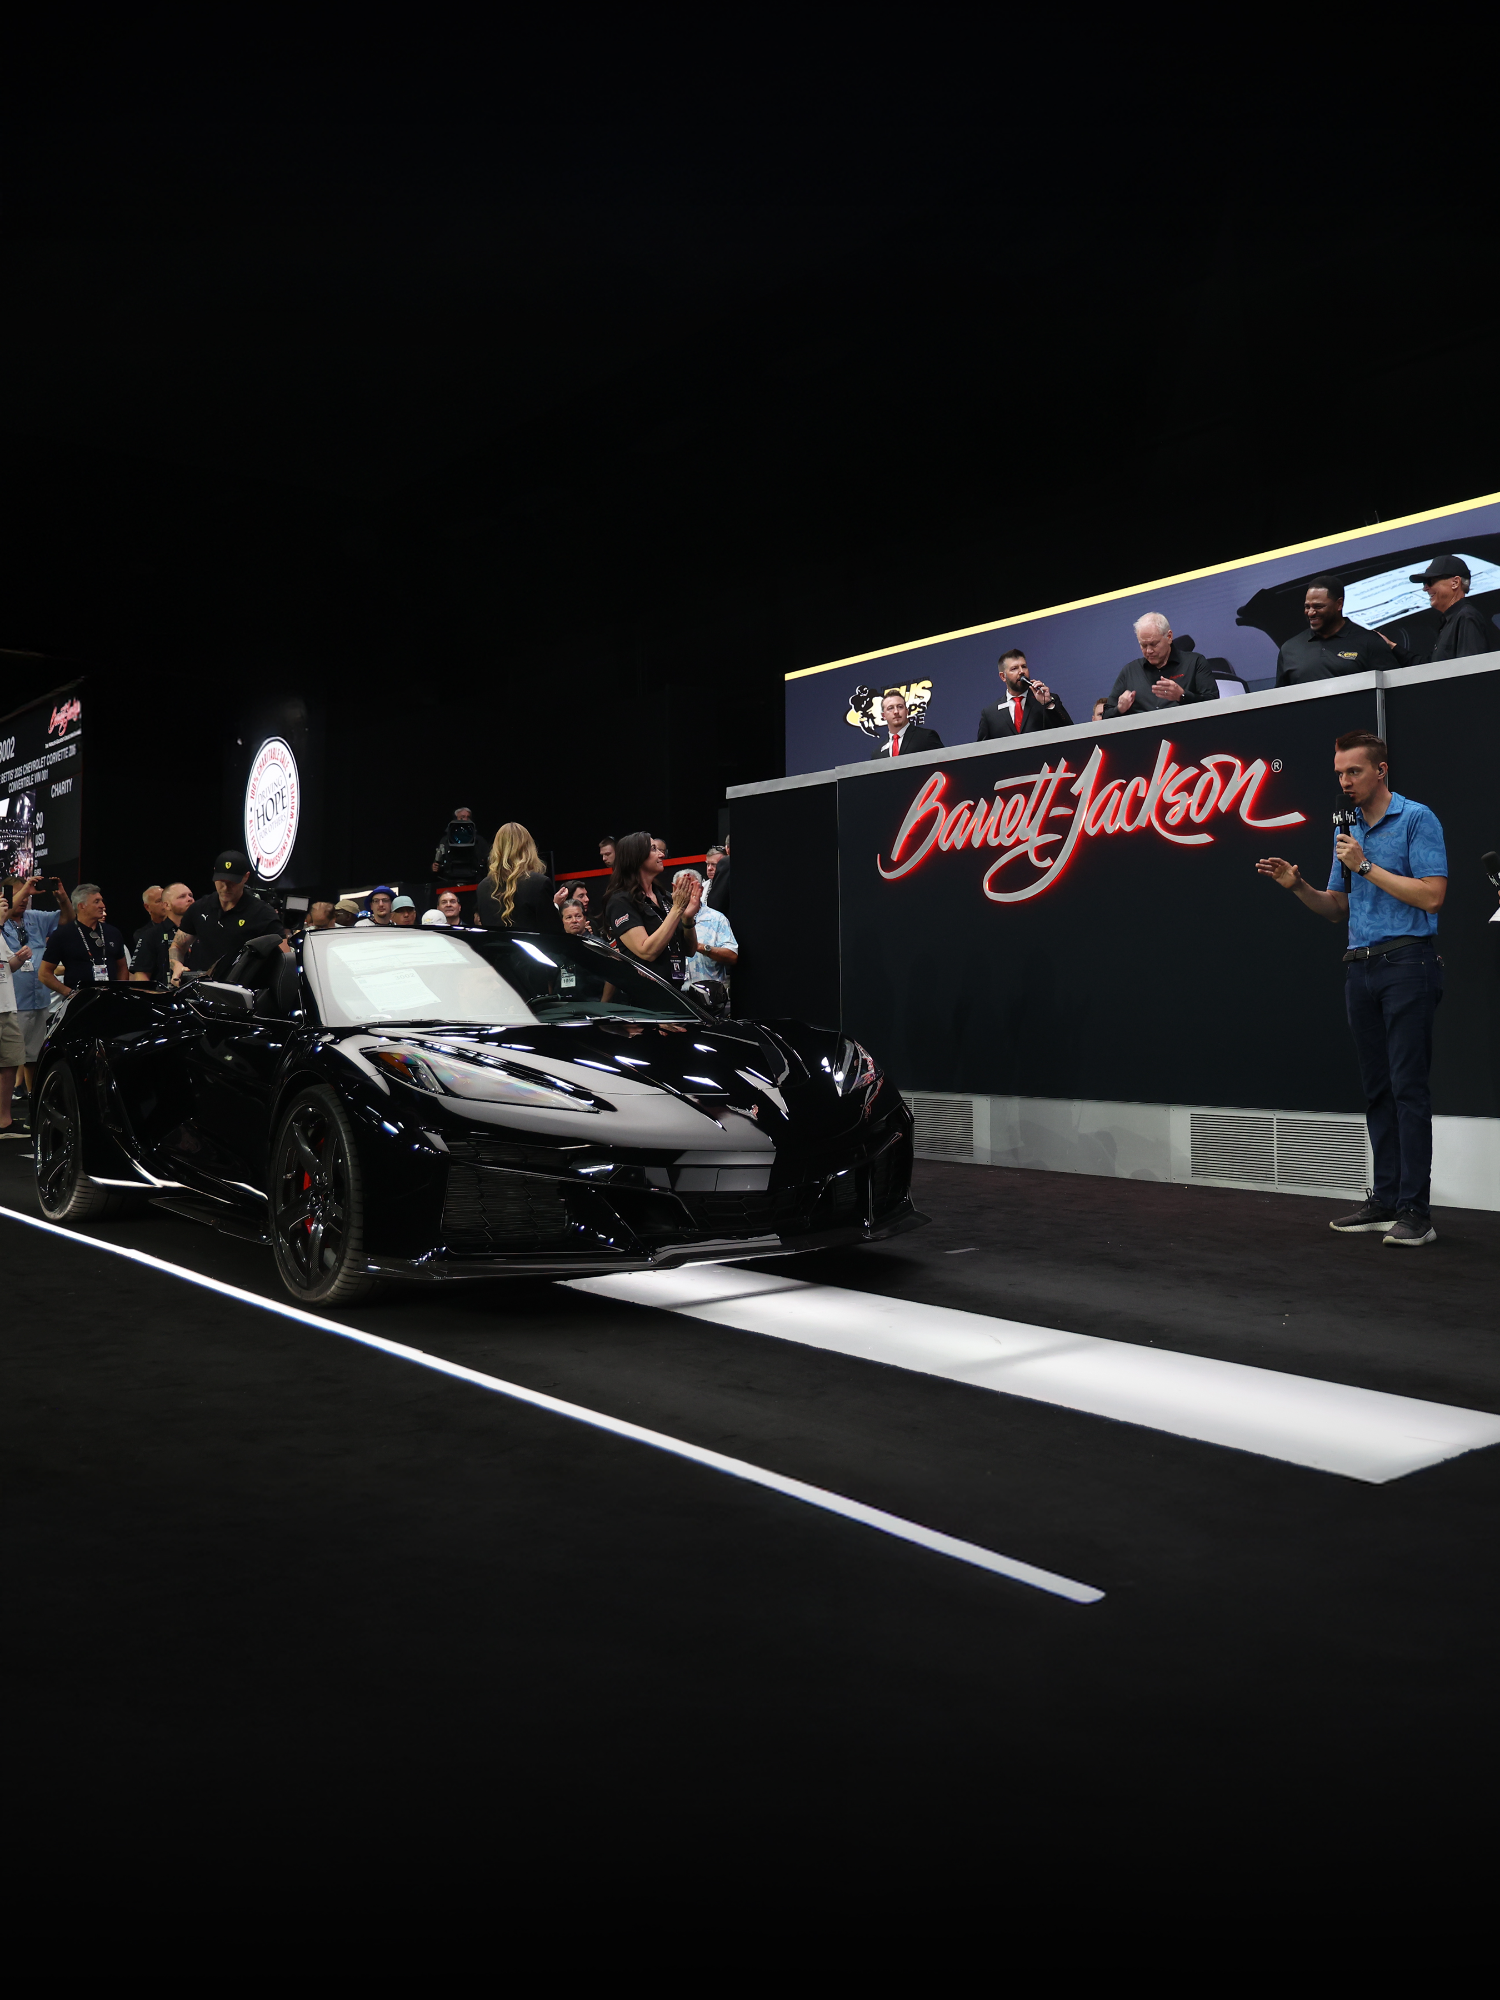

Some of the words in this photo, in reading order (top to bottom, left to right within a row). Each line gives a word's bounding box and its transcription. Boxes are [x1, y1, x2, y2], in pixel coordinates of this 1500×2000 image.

[23, 755, 47, 775] CHEVROLET
[46, 747, 69, 766] CORVETTE
[256, 747, 280, 776] CHARITABLE
[280, 750, 290, 771] SALE
[8, 773, 34, 793] CONVERTIBLE
[33, 771, 41, 784] VIN
[50, 778, 73, 798] CHARITY
[257, 775, 284, 804] DRIVING
[35, 811, 44, 831] $0
[255, 786, 288, 831] HOPE
[877, 739, 1306, 902] Barrett-Jackson
[35, 833, 45, 846] USD
[263, 839, 289, 869] COMMISSIONS
[285, 822, 293, 840] ARE
[394, 973, 415, 981] 3002
